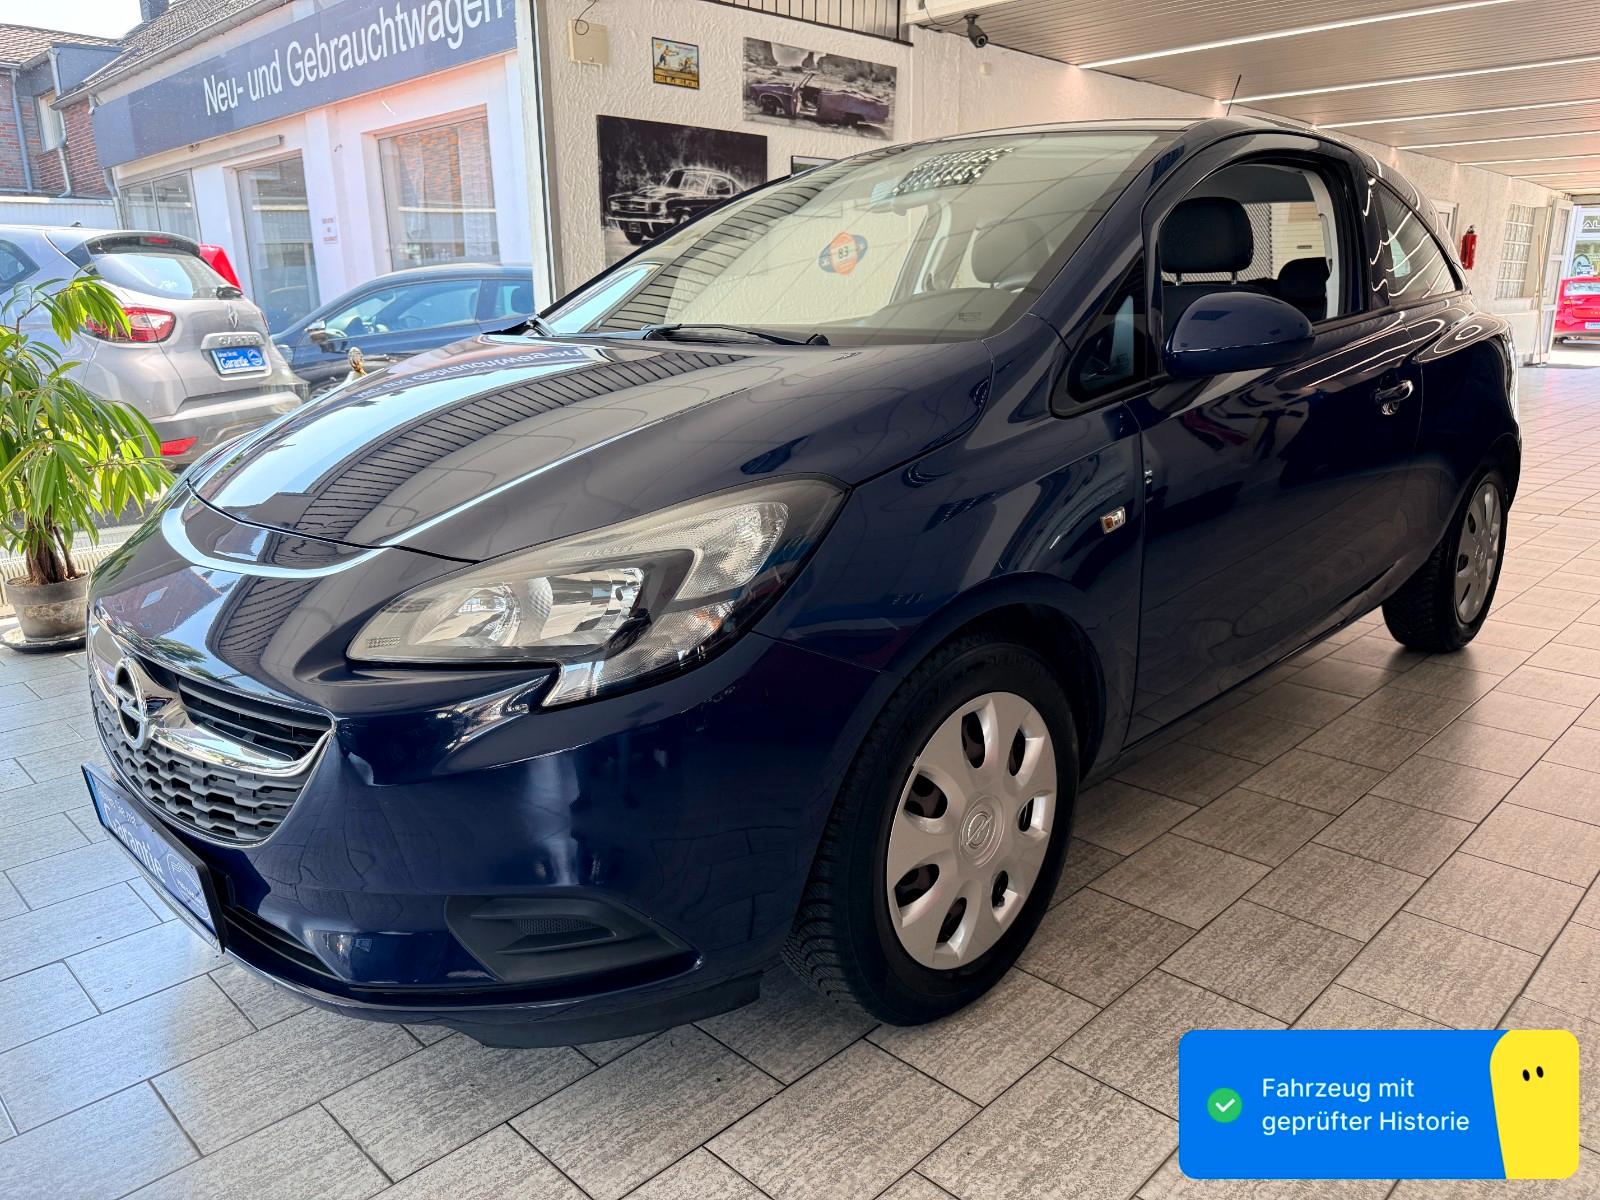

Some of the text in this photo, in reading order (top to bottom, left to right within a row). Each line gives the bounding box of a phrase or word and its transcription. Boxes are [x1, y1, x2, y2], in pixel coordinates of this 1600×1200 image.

[203, 0, 505, 116] Neu- und Gebrauchtwagen
